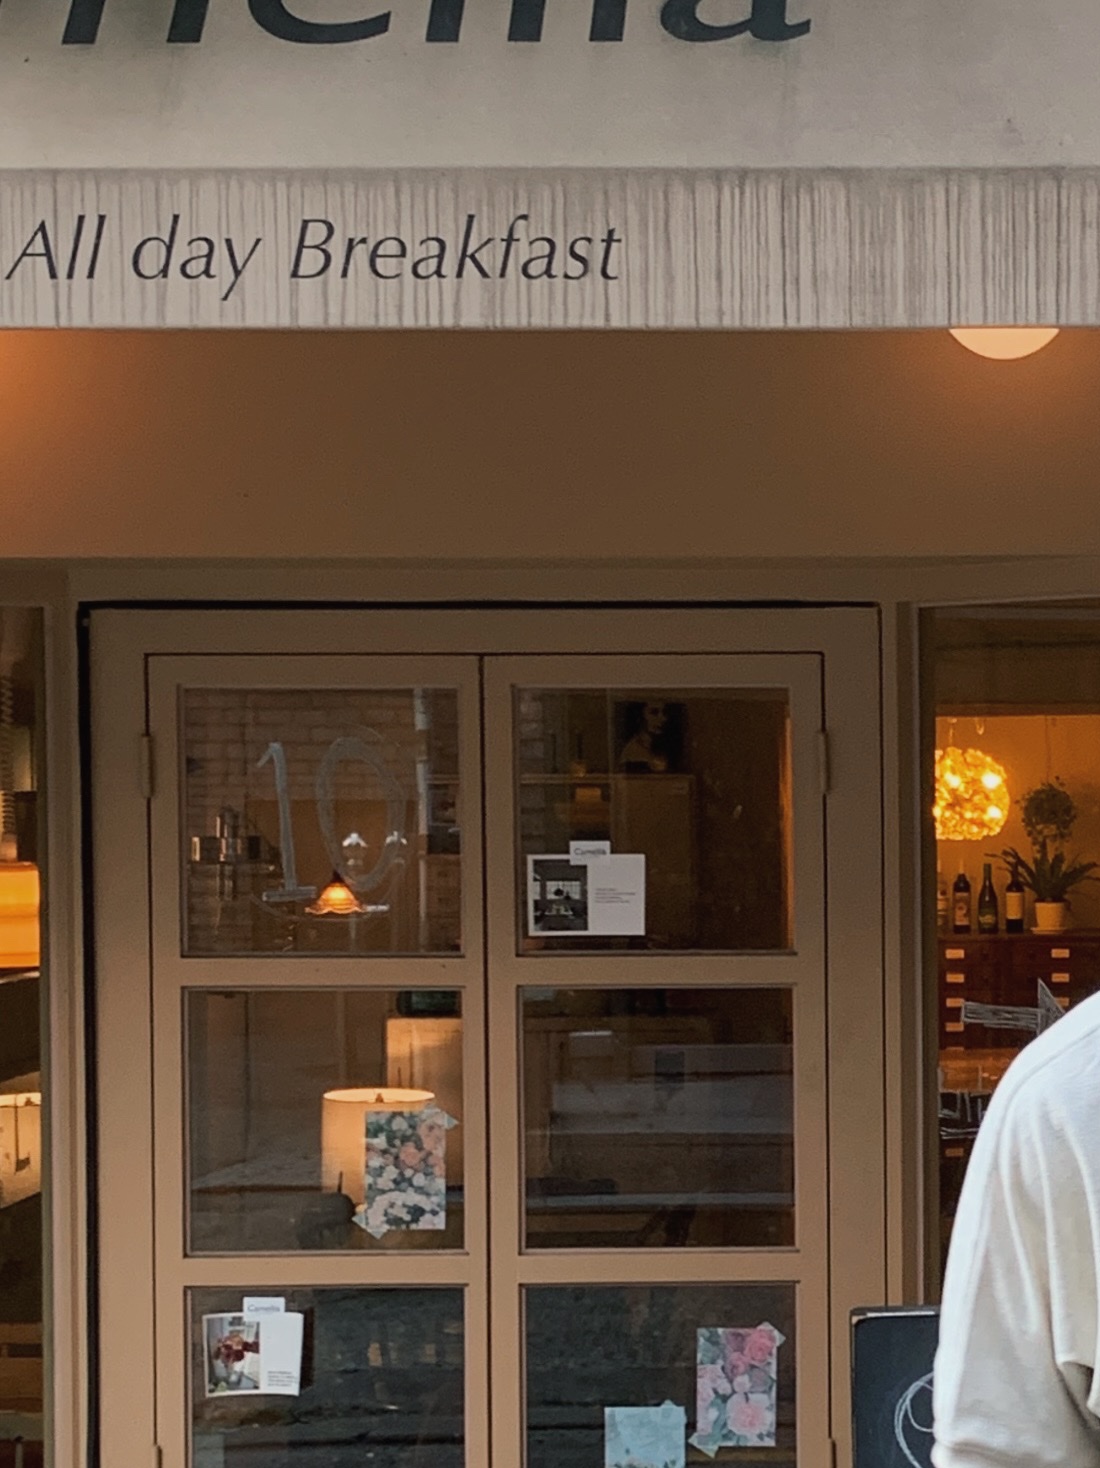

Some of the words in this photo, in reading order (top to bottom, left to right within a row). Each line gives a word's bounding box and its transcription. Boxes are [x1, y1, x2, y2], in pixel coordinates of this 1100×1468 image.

[5, 214, 107, 281] All
[131, 214, 262, 301] day
[290, 214, 623, 281] Breakfast
